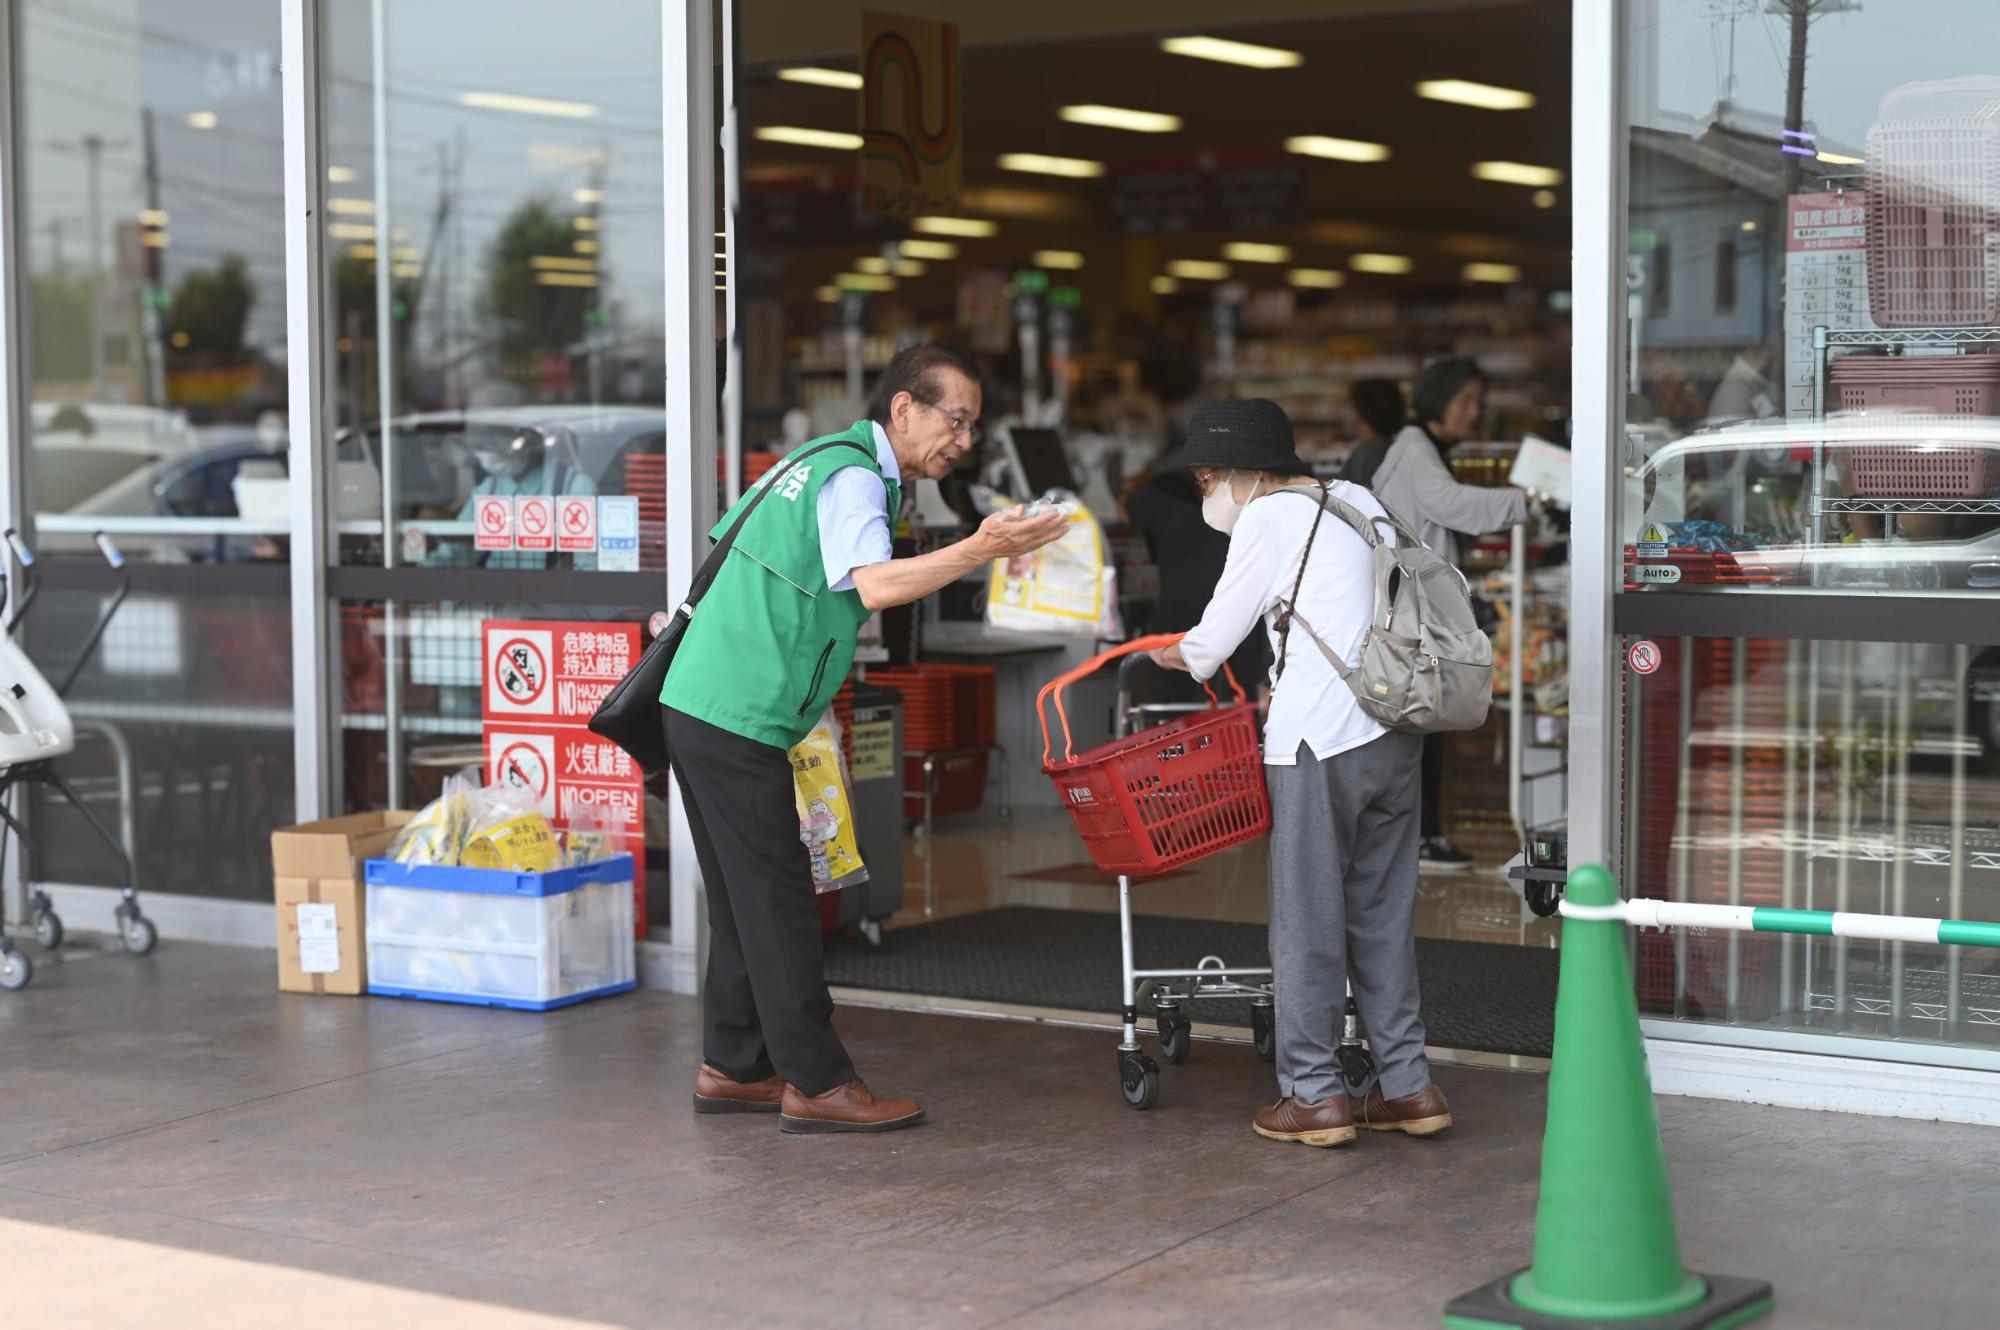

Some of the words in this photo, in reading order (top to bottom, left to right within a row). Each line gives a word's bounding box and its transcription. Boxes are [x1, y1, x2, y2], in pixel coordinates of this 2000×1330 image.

[1643, 569, 1669, 577] Auto
[563, 632, 630, 655] 危険物品
[563, 656, 630, 677] 持込厳禁
[558, 681, 576, 716] NO
[565, 742, 632, 777] 火気厳禁
[579, 788, 638, 806] OPEN
